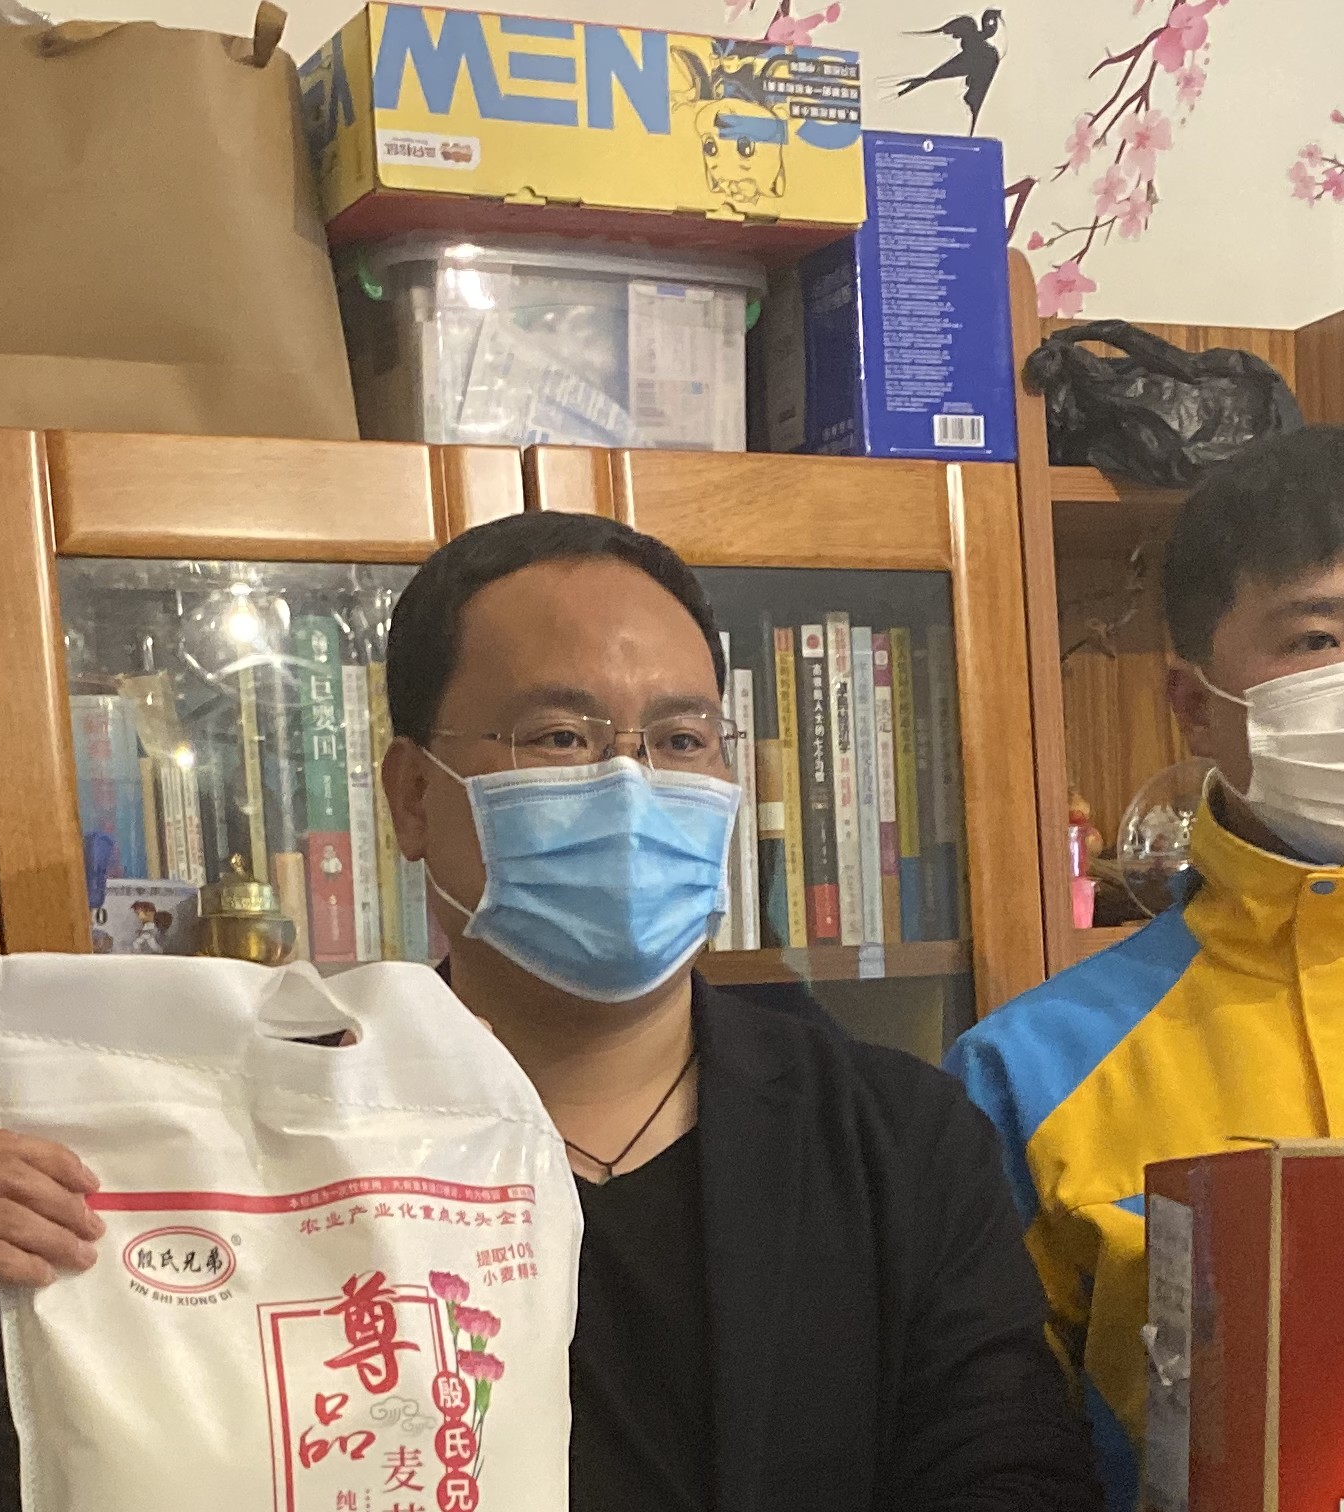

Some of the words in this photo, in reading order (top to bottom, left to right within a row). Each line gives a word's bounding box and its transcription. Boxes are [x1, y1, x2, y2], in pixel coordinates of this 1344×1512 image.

[129, 1278, 150, 1296] YIN
[151, 1291, 173, 1305] SHI
[176, 1293, 218, 1306] XIONG
[219, 1288, 233, 1302] DI
